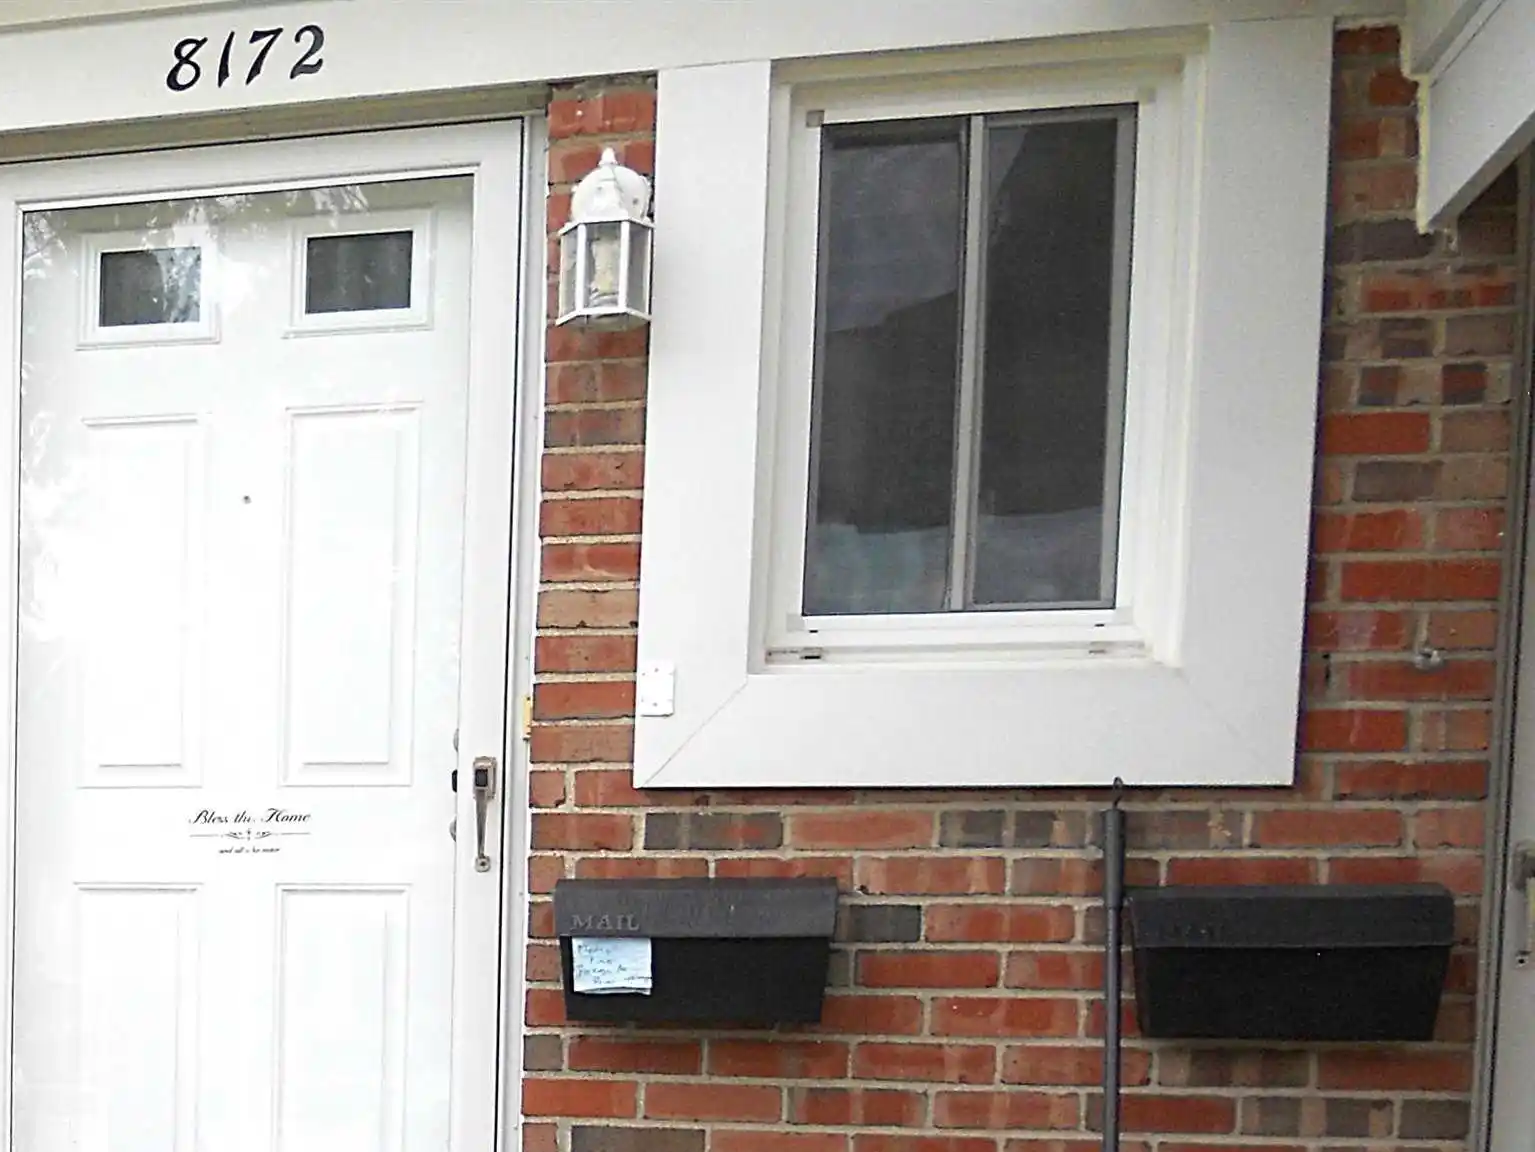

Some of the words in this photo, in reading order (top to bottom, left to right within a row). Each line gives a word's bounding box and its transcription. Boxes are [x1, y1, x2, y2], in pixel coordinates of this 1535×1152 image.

[166, 24, 325, 92] 8172
[265, 807, 311, 823] Home
[570, 913, 641, 932] MAIL
